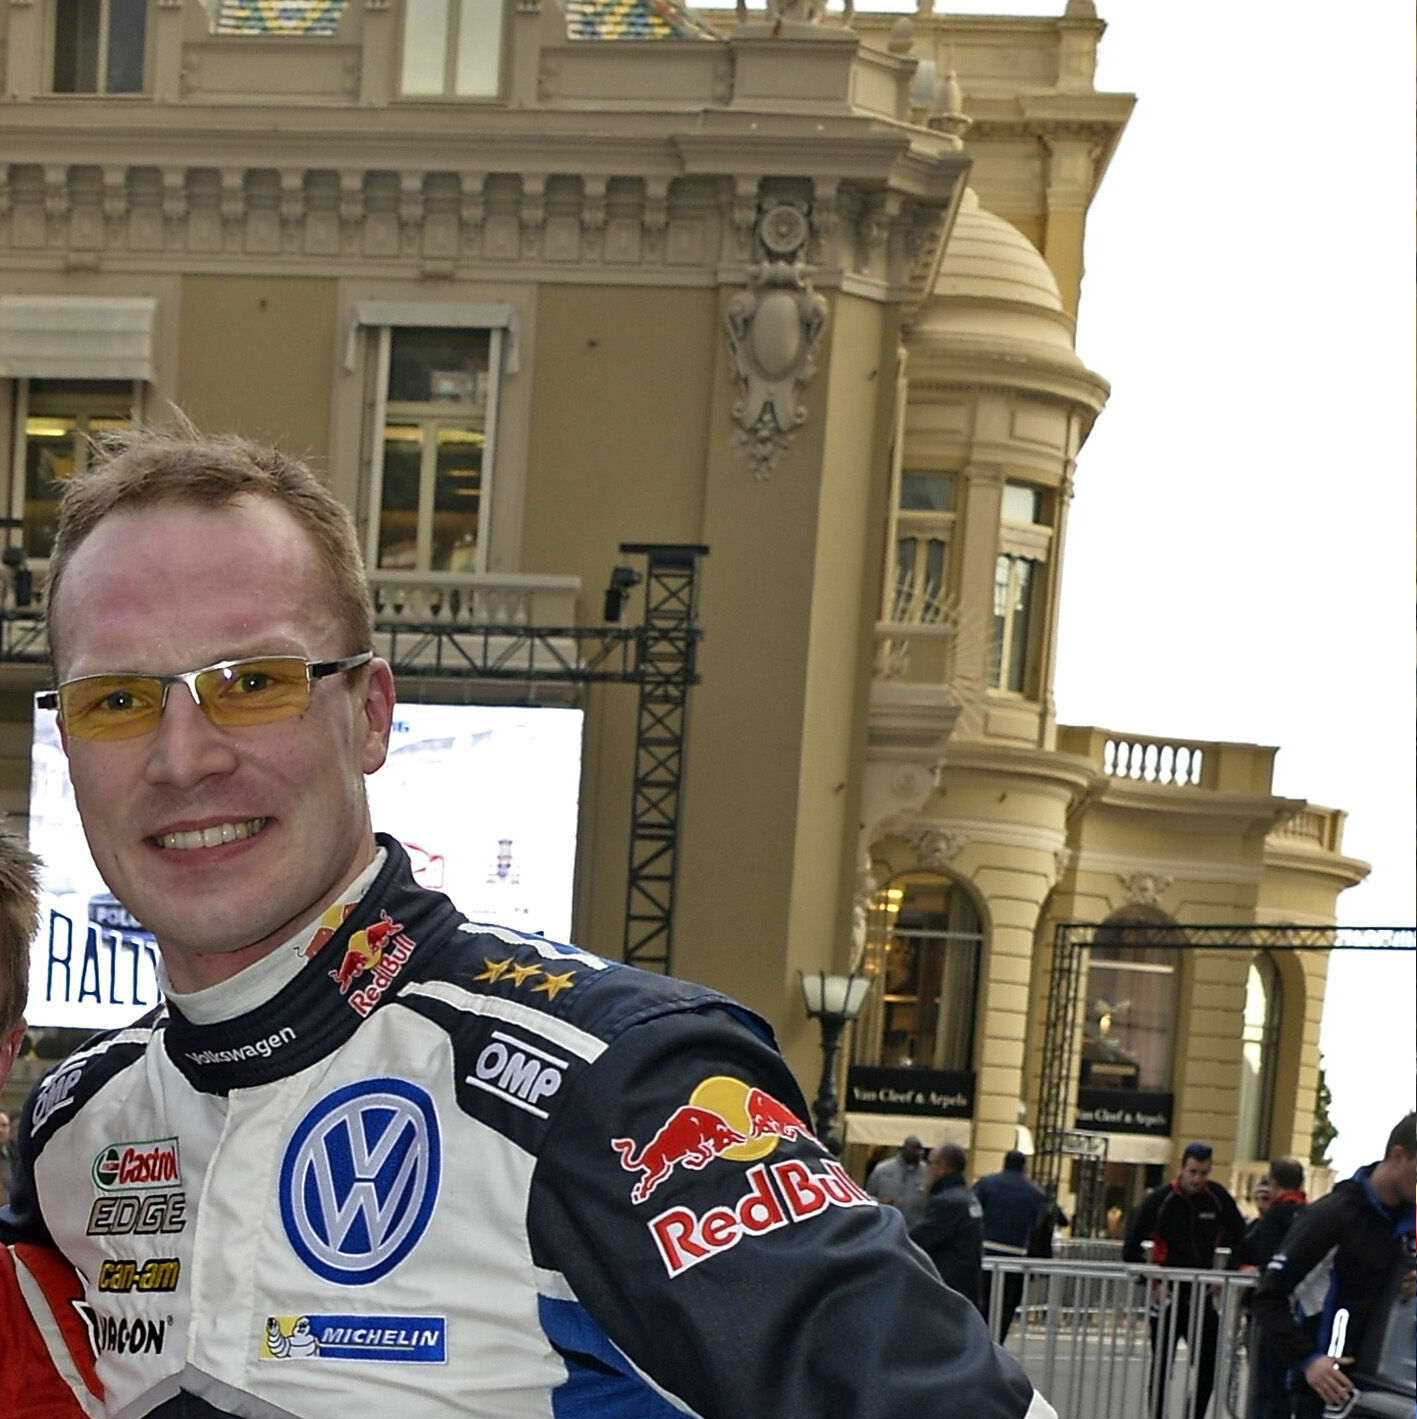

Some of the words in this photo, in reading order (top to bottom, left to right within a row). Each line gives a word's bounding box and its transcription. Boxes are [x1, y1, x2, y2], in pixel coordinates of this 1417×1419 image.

[349, 964, 390, 1018] Red
[384, 933, 416, 976] Bull
[185, 1026, 297, 1066] Volkswagen
[475, 1042, 562, 1104] OMP
[854, 1087, 877, 1101] Van
[879, 1087, 913, 1103] Cleef
[915, 1093, 925, 1104] &
[930, 1091, 968, 1108] Arpels
[119, 1146, 179, 1185] Castrol
[86, 1193, 186, 1236] EDGE
[648, 1164, 789, 1279] Red
[770, 1159, 878, 1223] Bull
[99, 1258, 181, 1293] can-am
[322, 1326, 440, 1347] MICHELIN
